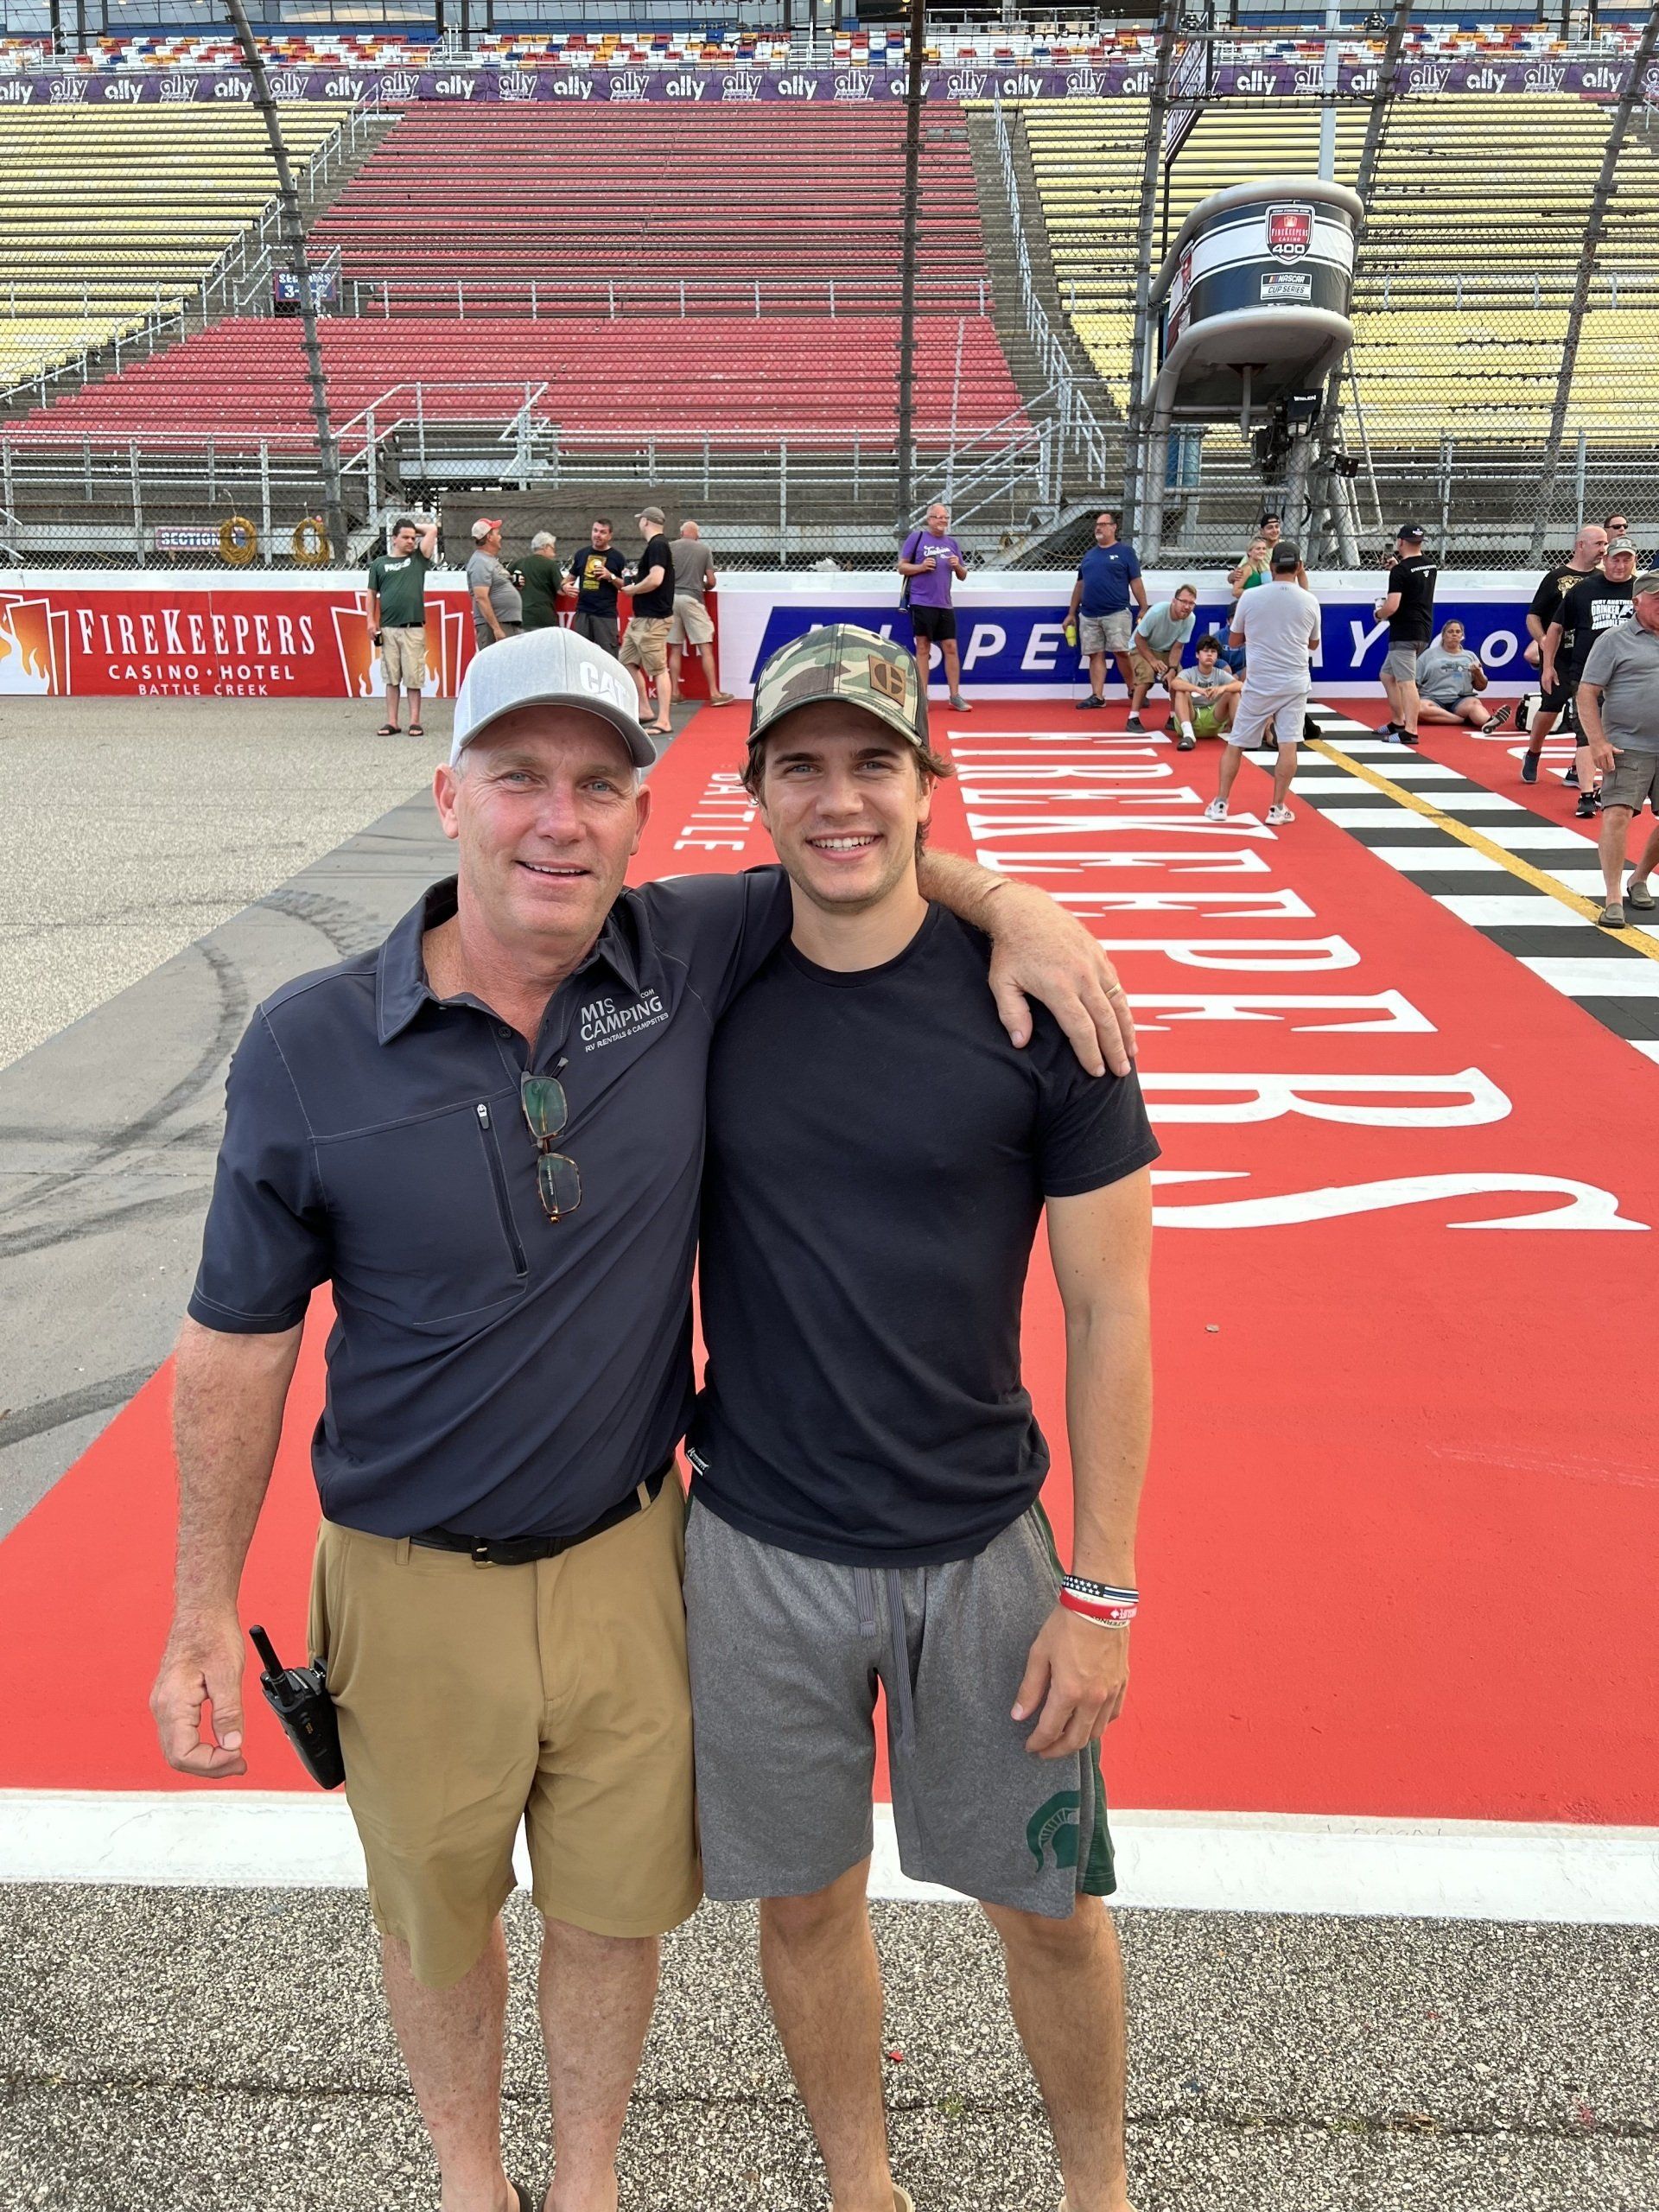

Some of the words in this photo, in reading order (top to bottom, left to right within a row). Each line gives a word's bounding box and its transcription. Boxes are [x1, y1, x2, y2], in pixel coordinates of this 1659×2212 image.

[49, 76, 88, 99] ally
[105, 80, 143, 104] ally
[160, 75, 199, 102] ally
[214, 78, 252, 101] ally
[270, 73, 308, 100] ally
[325, 76, 363, 99] ally
[380, 71, 419, 100] ally
[435, 75, 474, 99] ally
[499, 70, 537, 100] ally
[554, 76, 593, 99] ally
[610, 71, 649, 98] ally
[666, 75, 705, 100] ally
[722, 71, 761, 98] ally
[779, 75, 817, 99] ally
[834, 70, 874, 98] ally
[947, 70, 987, 98] ally
[1004, 74, 1042, 98] ally
[1066, 68, 1106, 95] ally
[1237, 71, 1276, 94] ally
[1408, 65, 1450, 92] ally
[1466, 69, 1506, 93] ally
[1523, 64, 1565, 92] ally
[1582, 68, 1623, 92] ally
[1273, 244, 1305, 253] 400
[161, 532, 220, 545] SECTION
[1592, 605, 1620, 615] DRINKER
[108, 664, 199, 680] CASINO
[220, 665, 295, 680] HOTEL
[138, 683, 200, 696] BATTLE
[214, 683, 268, 696] CREEK
[580, 661, 628, 707] CAT
[581, 997, 615, 1024] MIS
[581, 995, 663, 1041] CAMPING
[585, 1044, 595, 1052] RV
[597, 1031, 626, 1048] RENTALS
[632, 1012, 669, 1033] CAMPSITES
